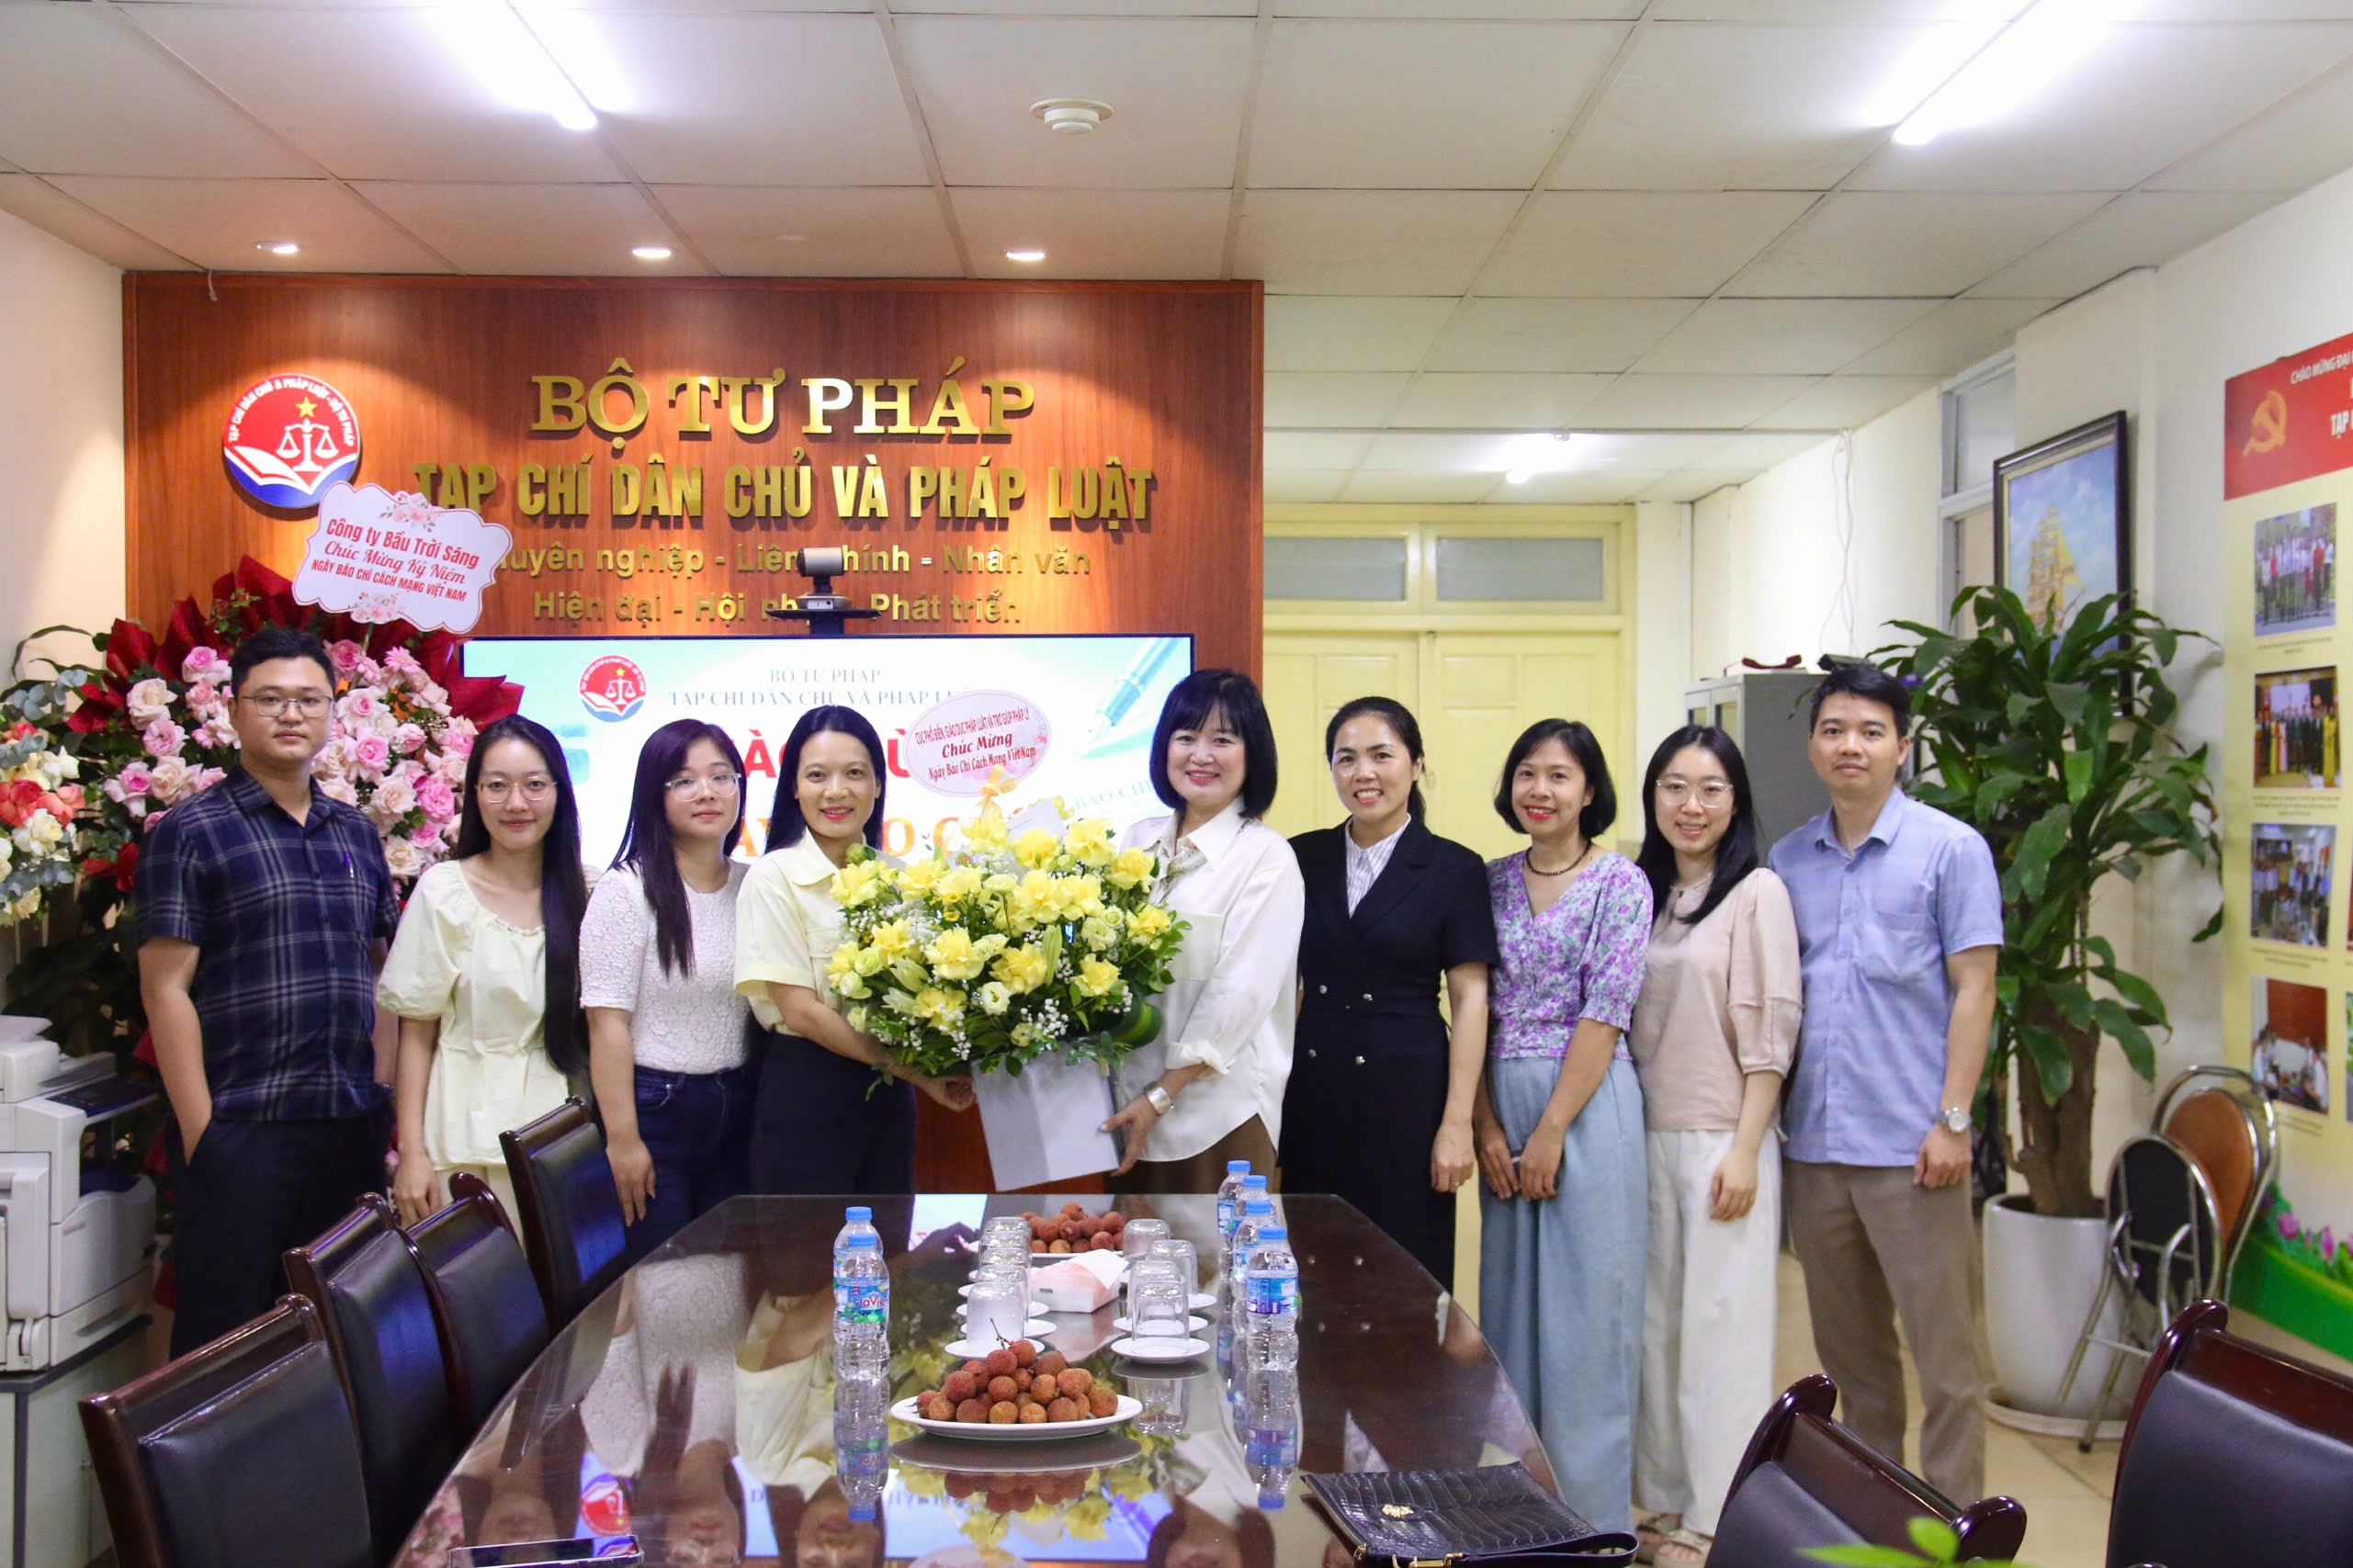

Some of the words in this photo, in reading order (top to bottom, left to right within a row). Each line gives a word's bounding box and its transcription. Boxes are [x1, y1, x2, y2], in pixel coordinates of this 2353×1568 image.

[531, 357, 649, 449] BỘ
[668, 368, 786, 434] TƯ
[801, 355, 1035, 435] PHÁP
[517, 453, 594, 516] CHÍ
[613, 453, 702, 517] DÂN
[725, 446, 812, 519] CHỦ
[831, 454, 888, 518] VÀ
[910, 456, 1026, 518] PHÁP
[1048, 456, 1154, 530] LUẬT
[324, 540, 359, 560] Chúc
[363, 548, 404, 574] Mừng
[430, 565, 466, 585] Niệm
[326, 518, 363, 542] Công
[365, 527, 381, 546] ty
[382, 531, 411, 552] Bầu
[413, 537, 442, 558] Trời
[443, 546, 480, 570] Sáng
[499, 541, 583, 577] uyên
[596, 544, 705, 579] nghiệp
[843, 544, 910, 572] hính
[943, 545, 1023, 574] Nhân
[1035, 545, 1091, 575] văn
[311, 558, 335, 572] NGÀY
[335, 563, 355, 578] BÁO
[356, 569, 371, 581] CHÍ
[372, 571, 396, 586] CÁCH
[398, 578, 424, 593] MẠNG
[426, 581, 444, 598] VIỆT
[447, 588, 467, 602] NAM
[534, 591, 605, 626] Hiện
[616, 592, 662, 627] đại
[696, 592, 745, 626] Hội
[870, 592, 941, 621] Phát
[951, 590, 1021, 624] triển
[942, 738, 974, 758] Chúc
[977, 733, 1012, 750] Mừng
